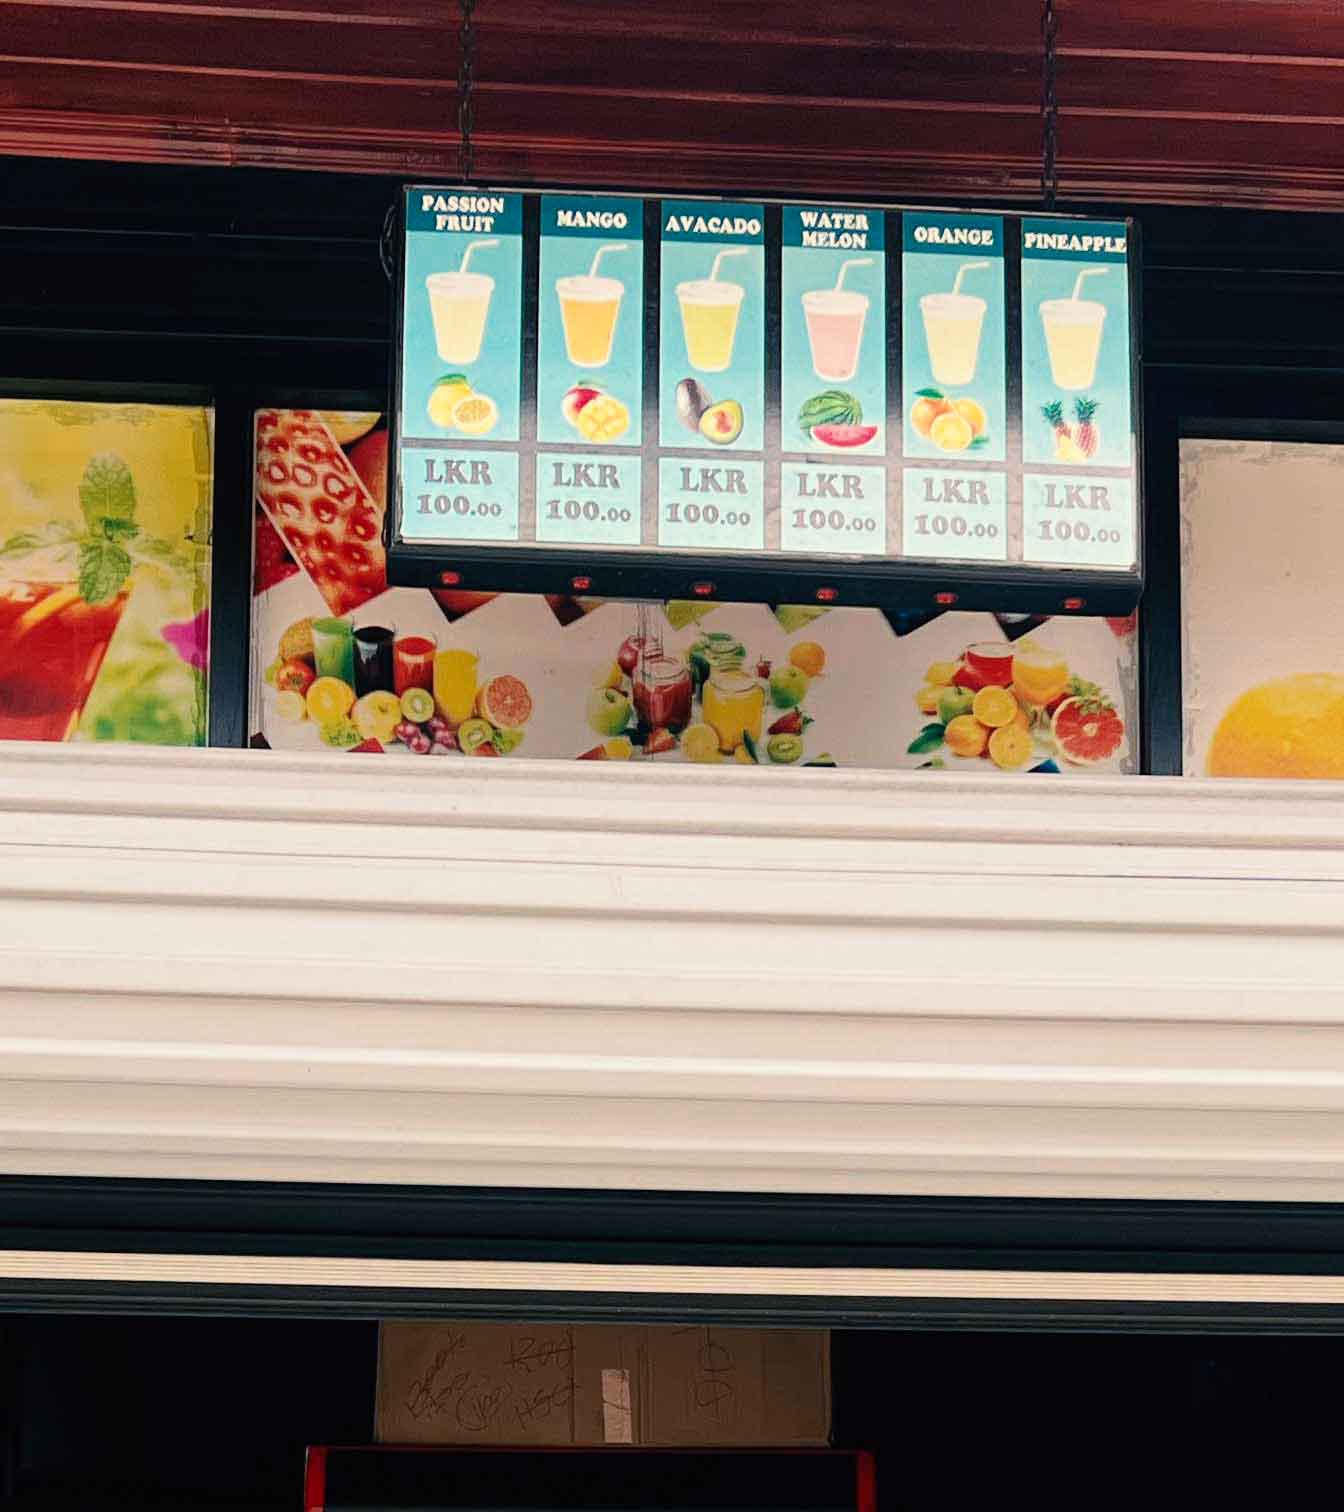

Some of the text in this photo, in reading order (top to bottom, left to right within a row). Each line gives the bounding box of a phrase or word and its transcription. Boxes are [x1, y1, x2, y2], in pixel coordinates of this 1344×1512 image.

[422, 195, 504, 214] PASSION
[435, 214, 494, 232] FRUIT
[557, 210, 627, 229] MANGO
[665, 215, 761, 235] AVACADO
[800, 210, 869, 230] WATER
[802, 230, 867, 249] MELON
[914, 226, 994, 246] ORANGE
[1024, 232, 1127, 253] PINEAPPLE
[425, 459, 492, 485] LKR
[553, 462, 620, 489] LKR
[680, 466, 748, 494] LKR
[797, 472, 864, 499] LKR
[922, 477, 990, 505] LKR
[1044, 483, 1111, 511] LKR
[416, 494, 502, 517] 100.00
[546, 499, 631, 523] 100.00
[665, 503, 751, 526] 100.00
[791, 509, 876, 532] 100.00
[915, 514, 998, 538] 100.00
[1037, 520, 1121, 543] 100.00
